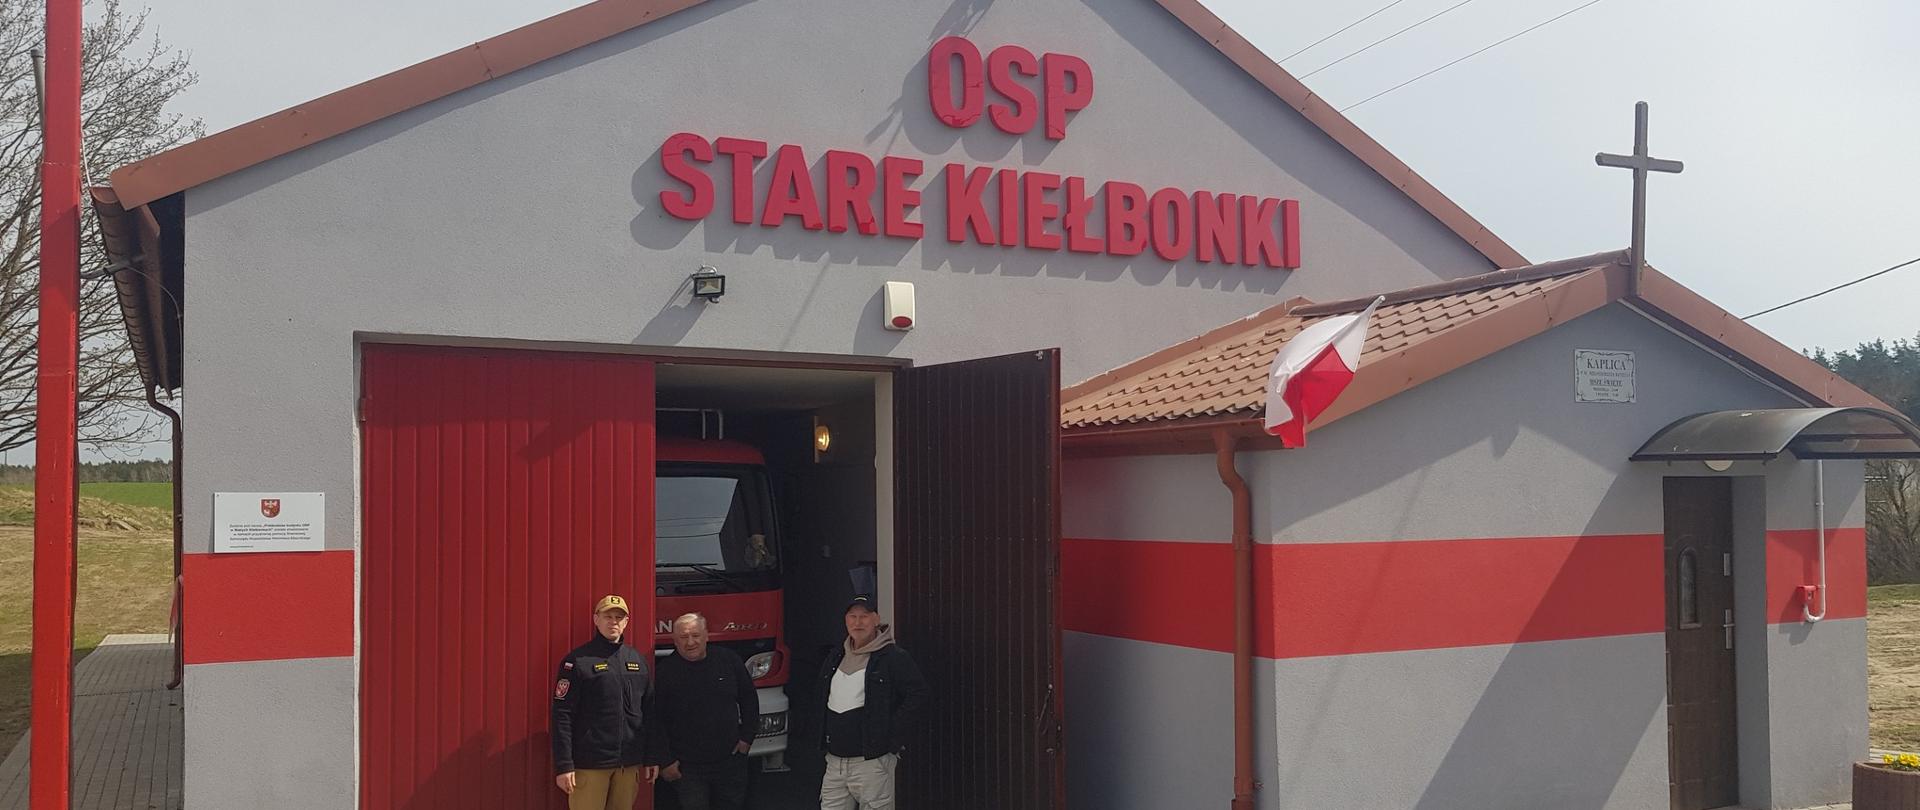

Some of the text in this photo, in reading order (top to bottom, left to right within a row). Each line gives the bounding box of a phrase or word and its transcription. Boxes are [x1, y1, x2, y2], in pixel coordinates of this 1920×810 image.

[928, 35, 1094, 141] OSP
[659, 132, 1301, 269] STARE KIEŁBONKI
[1587, 358, 1626, 370] KAPLICA
